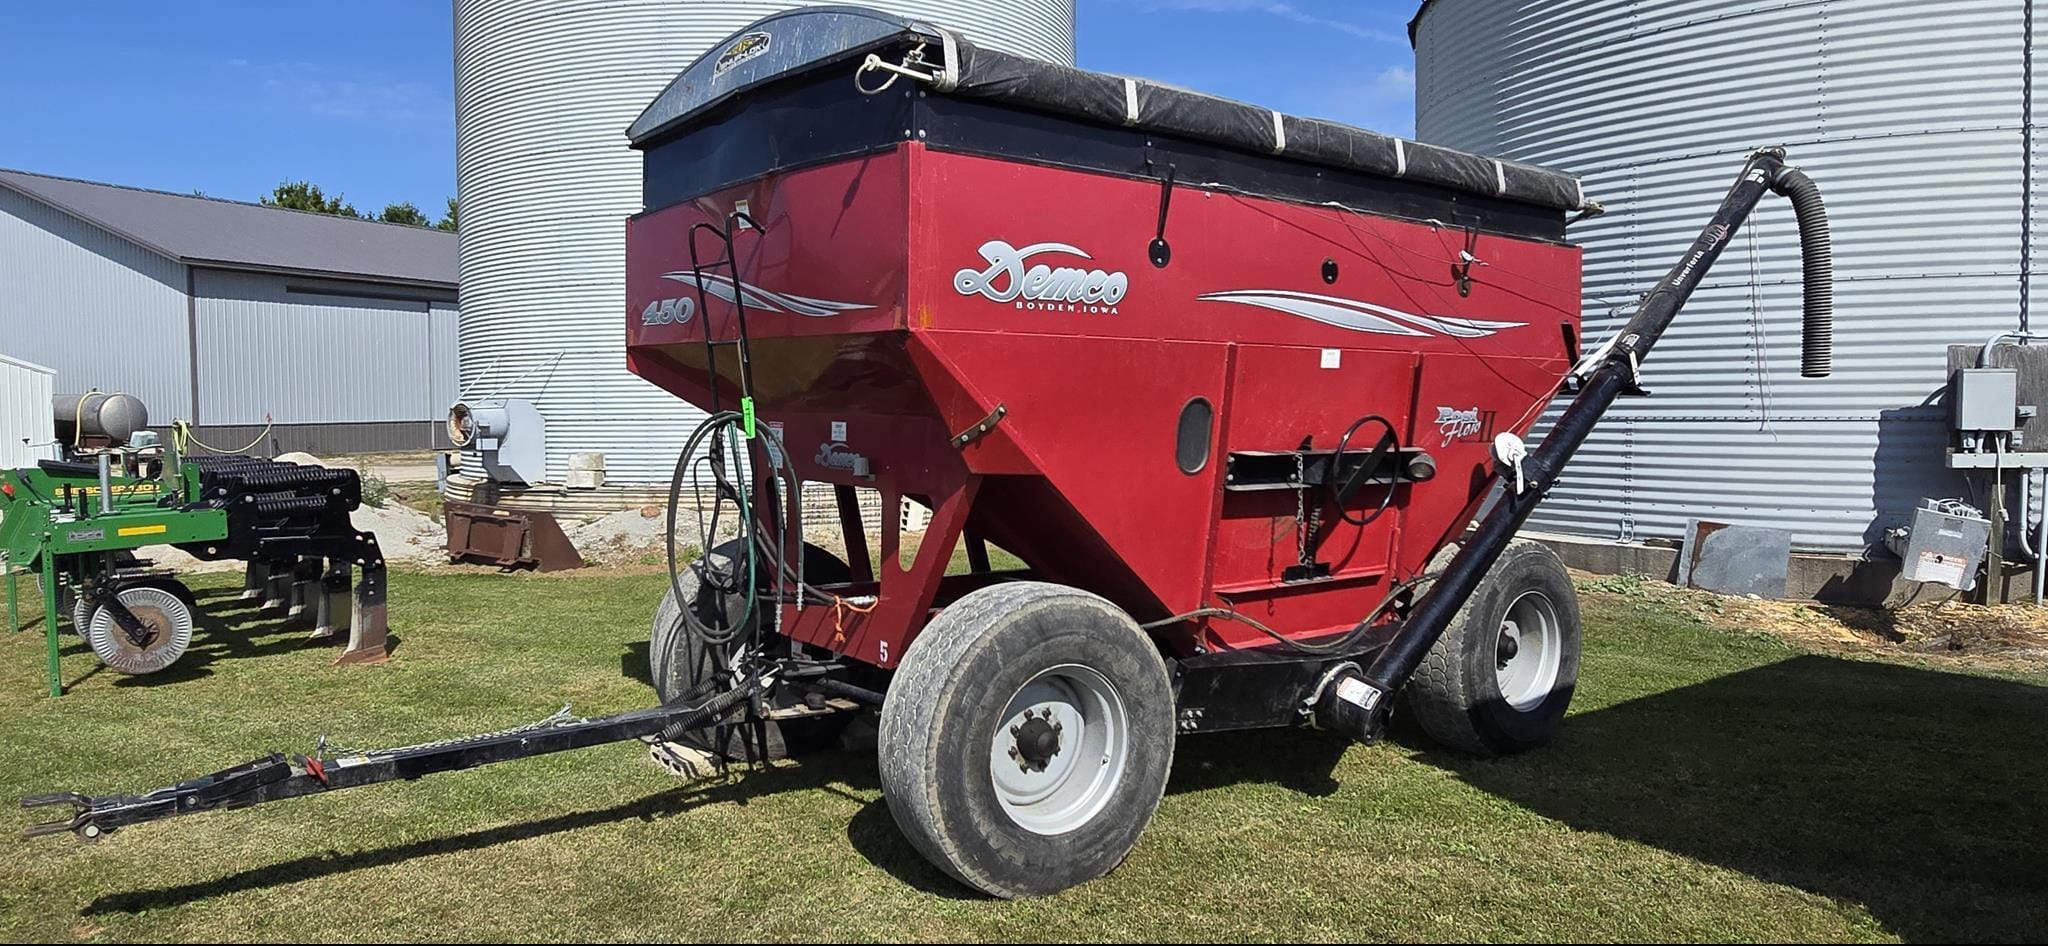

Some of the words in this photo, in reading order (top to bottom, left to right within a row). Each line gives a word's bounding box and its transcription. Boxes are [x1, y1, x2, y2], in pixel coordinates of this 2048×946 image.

[953, 240, 1128, 306] Demco
[641, 296, 695, 326] 450
[1083, 305, 1118, 315] IOWA
[1434, 406, 1479, 424] Posi
[1440, 419, 1482, 448] Flow
[879, 640, 889, 663] 5
